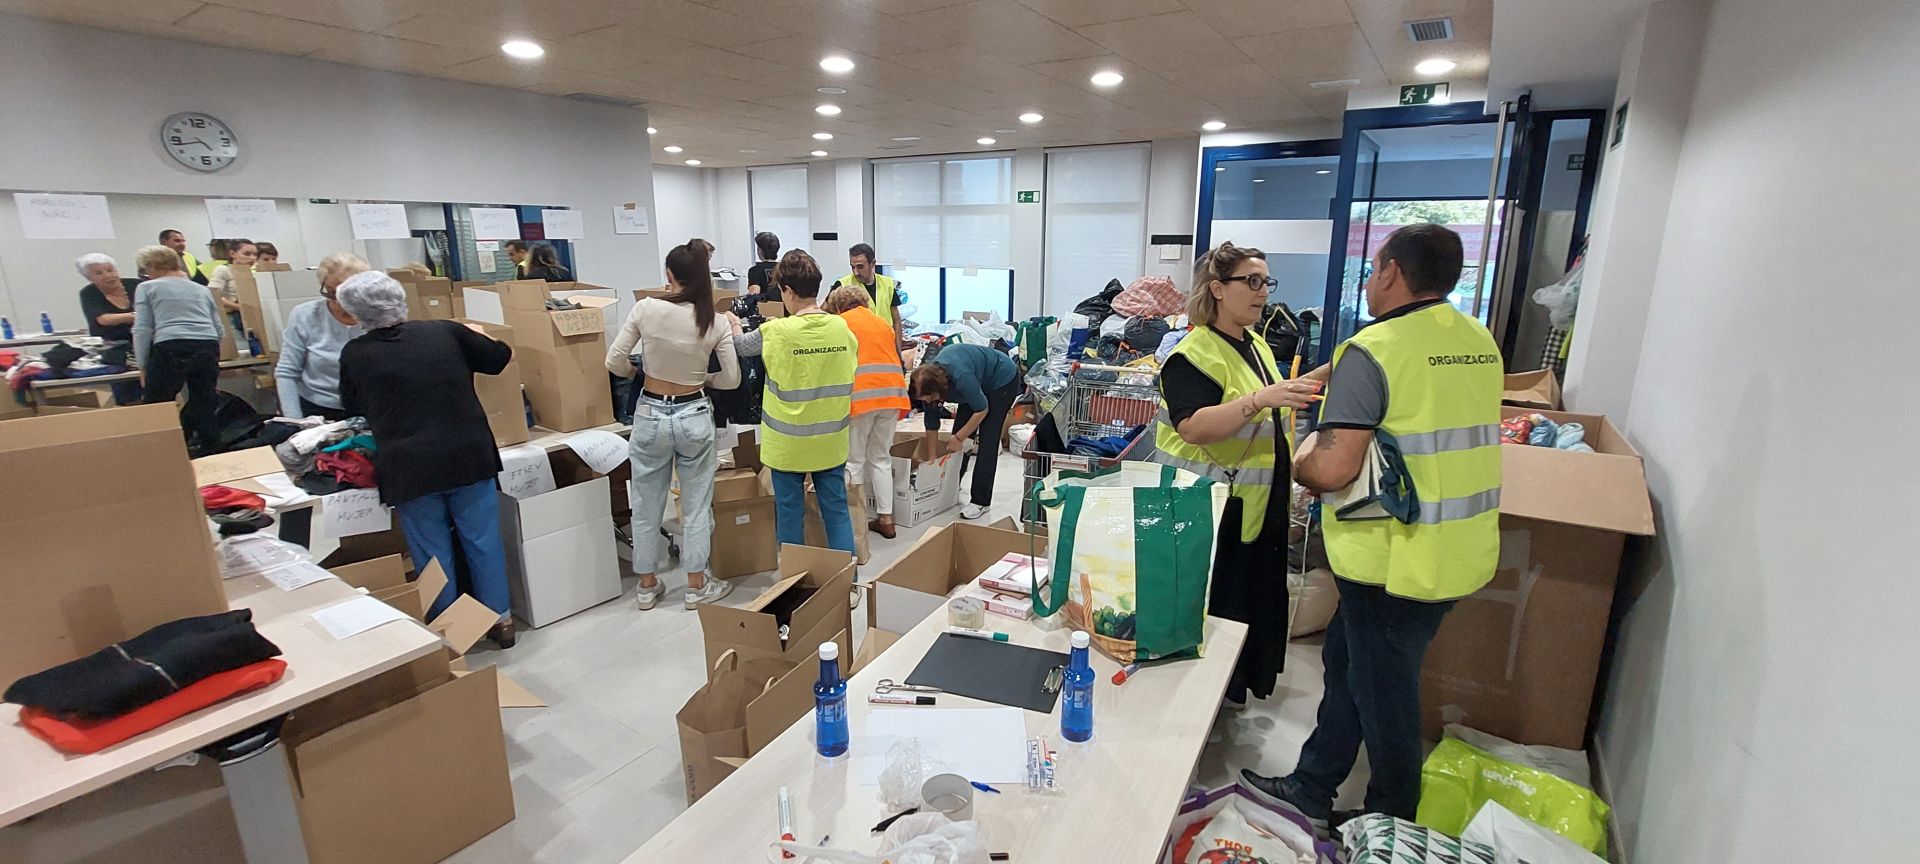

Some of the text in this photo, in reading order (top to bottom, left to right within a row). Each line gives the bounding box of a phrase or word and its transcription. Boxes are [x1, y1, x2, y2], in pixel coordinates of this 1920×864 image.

[188, 118, 206, 129] 12
[220, 137, 231, 148] 3
[200, 155, 212, 166] 6
[792, 345, 847, 356] ORGANIZACION
